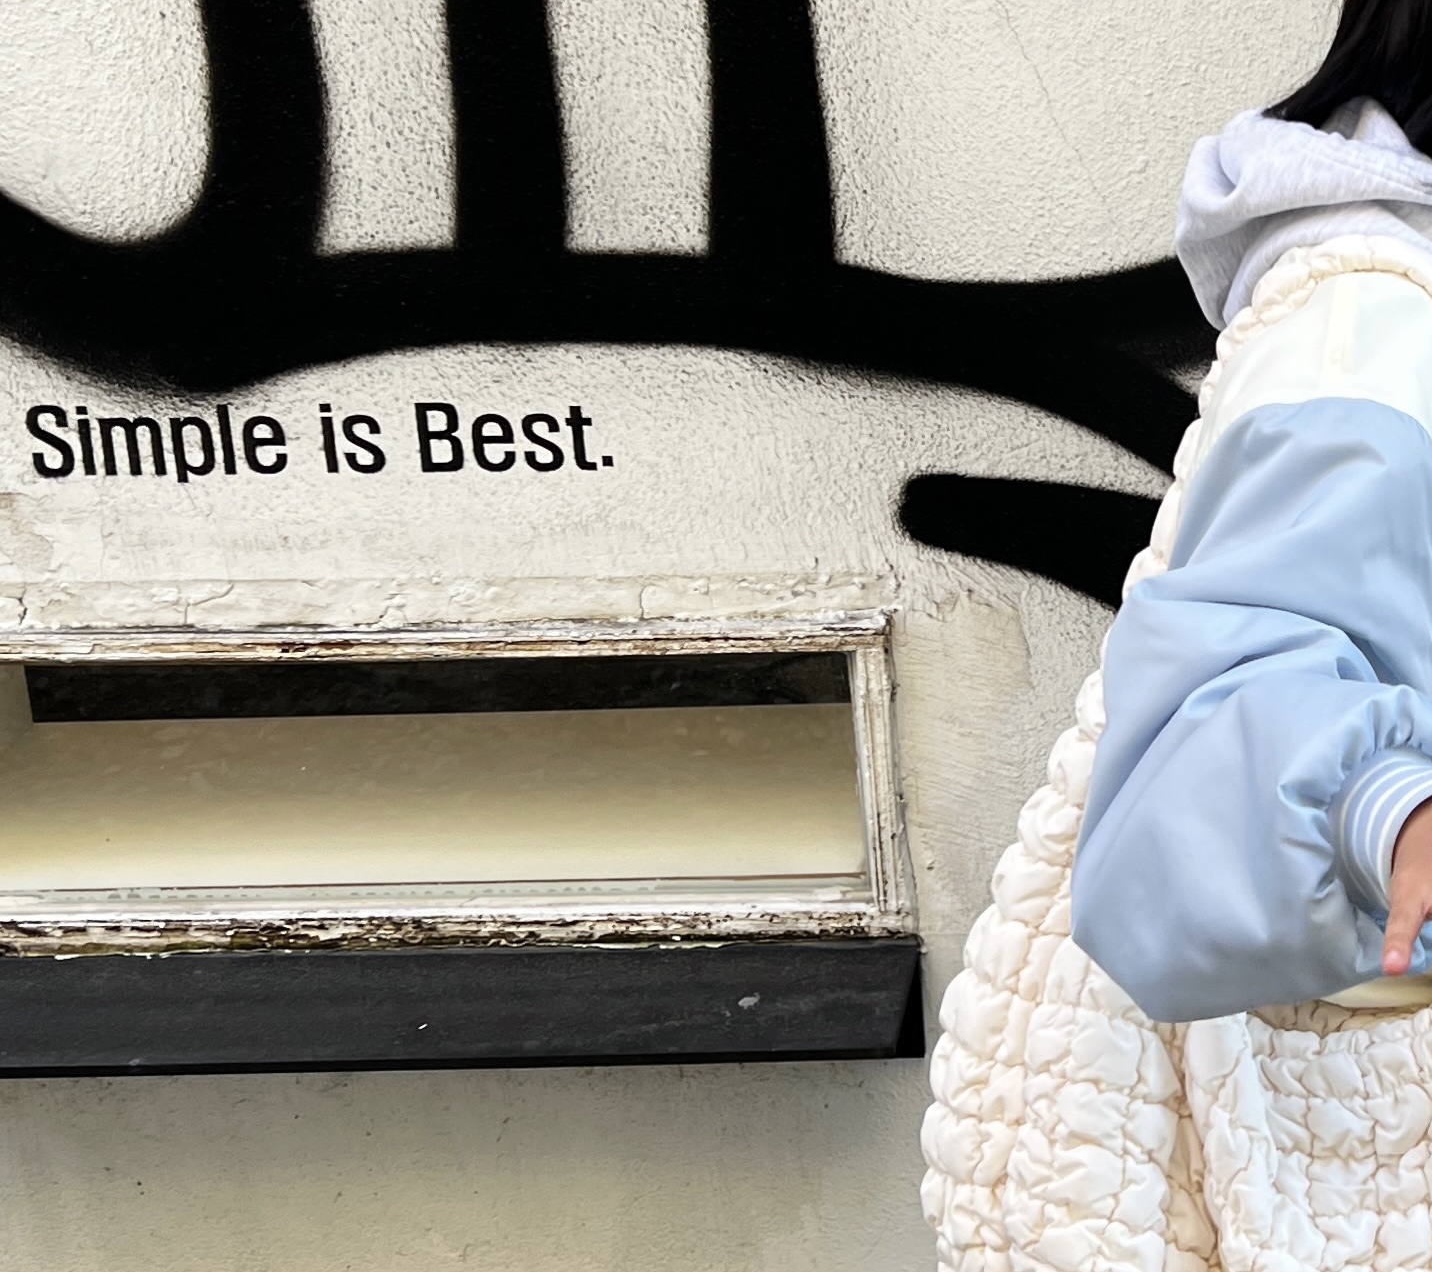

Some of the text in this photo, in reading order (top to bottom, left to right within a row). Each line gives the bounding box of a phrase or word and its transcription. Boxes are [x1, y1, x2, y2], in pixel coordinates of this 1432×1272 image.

[26, 402, 614, 483] Simple is Best.
